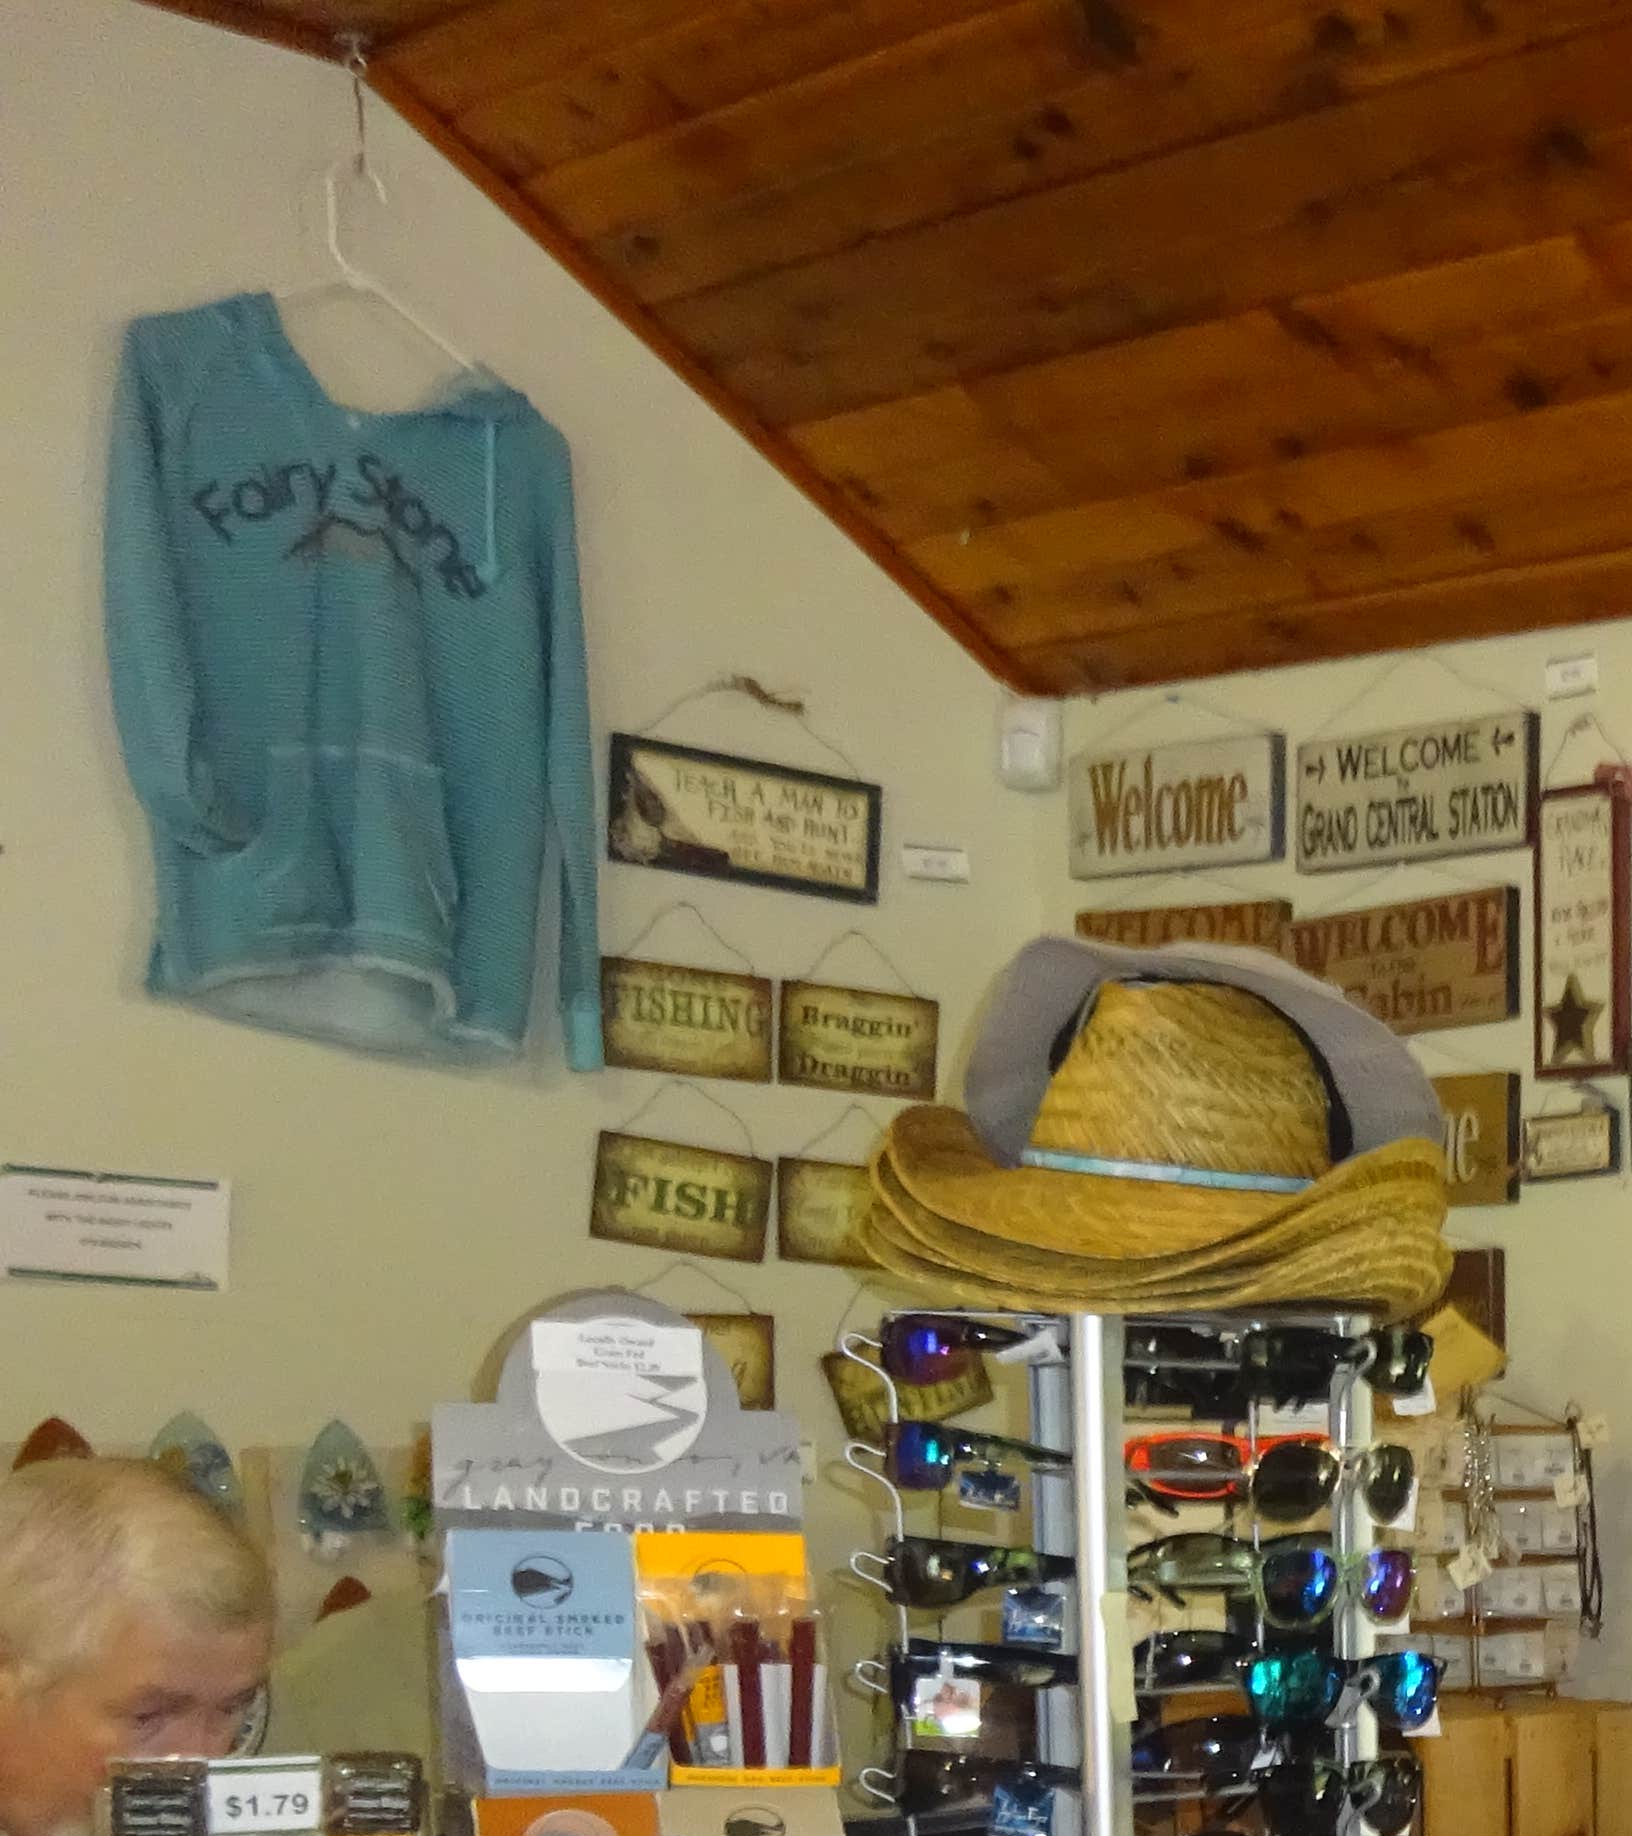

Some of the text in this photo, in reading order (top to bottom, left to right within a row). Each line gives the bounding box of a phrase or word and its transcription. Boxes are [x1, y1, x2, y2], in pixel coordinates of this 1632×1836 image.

[193, 455, 487, 600] Fairy Stone
[1336, 732, 1481, 783] WELCOME
[1088, 755, 1248, 857] Welcome
[1302, 782, 1519, 857] GRAND CENTRAL STATION
[610, 1172, 747, 1226] FISH
[462, 1486, 789, 1515] LANDCRAFTED
[462, 1613, 626, 1625] ORIGINAL SMOKED
[493, 1626, 594, 1637] BEEF STICK
[225, 1794, 310, 1819] $1.79
